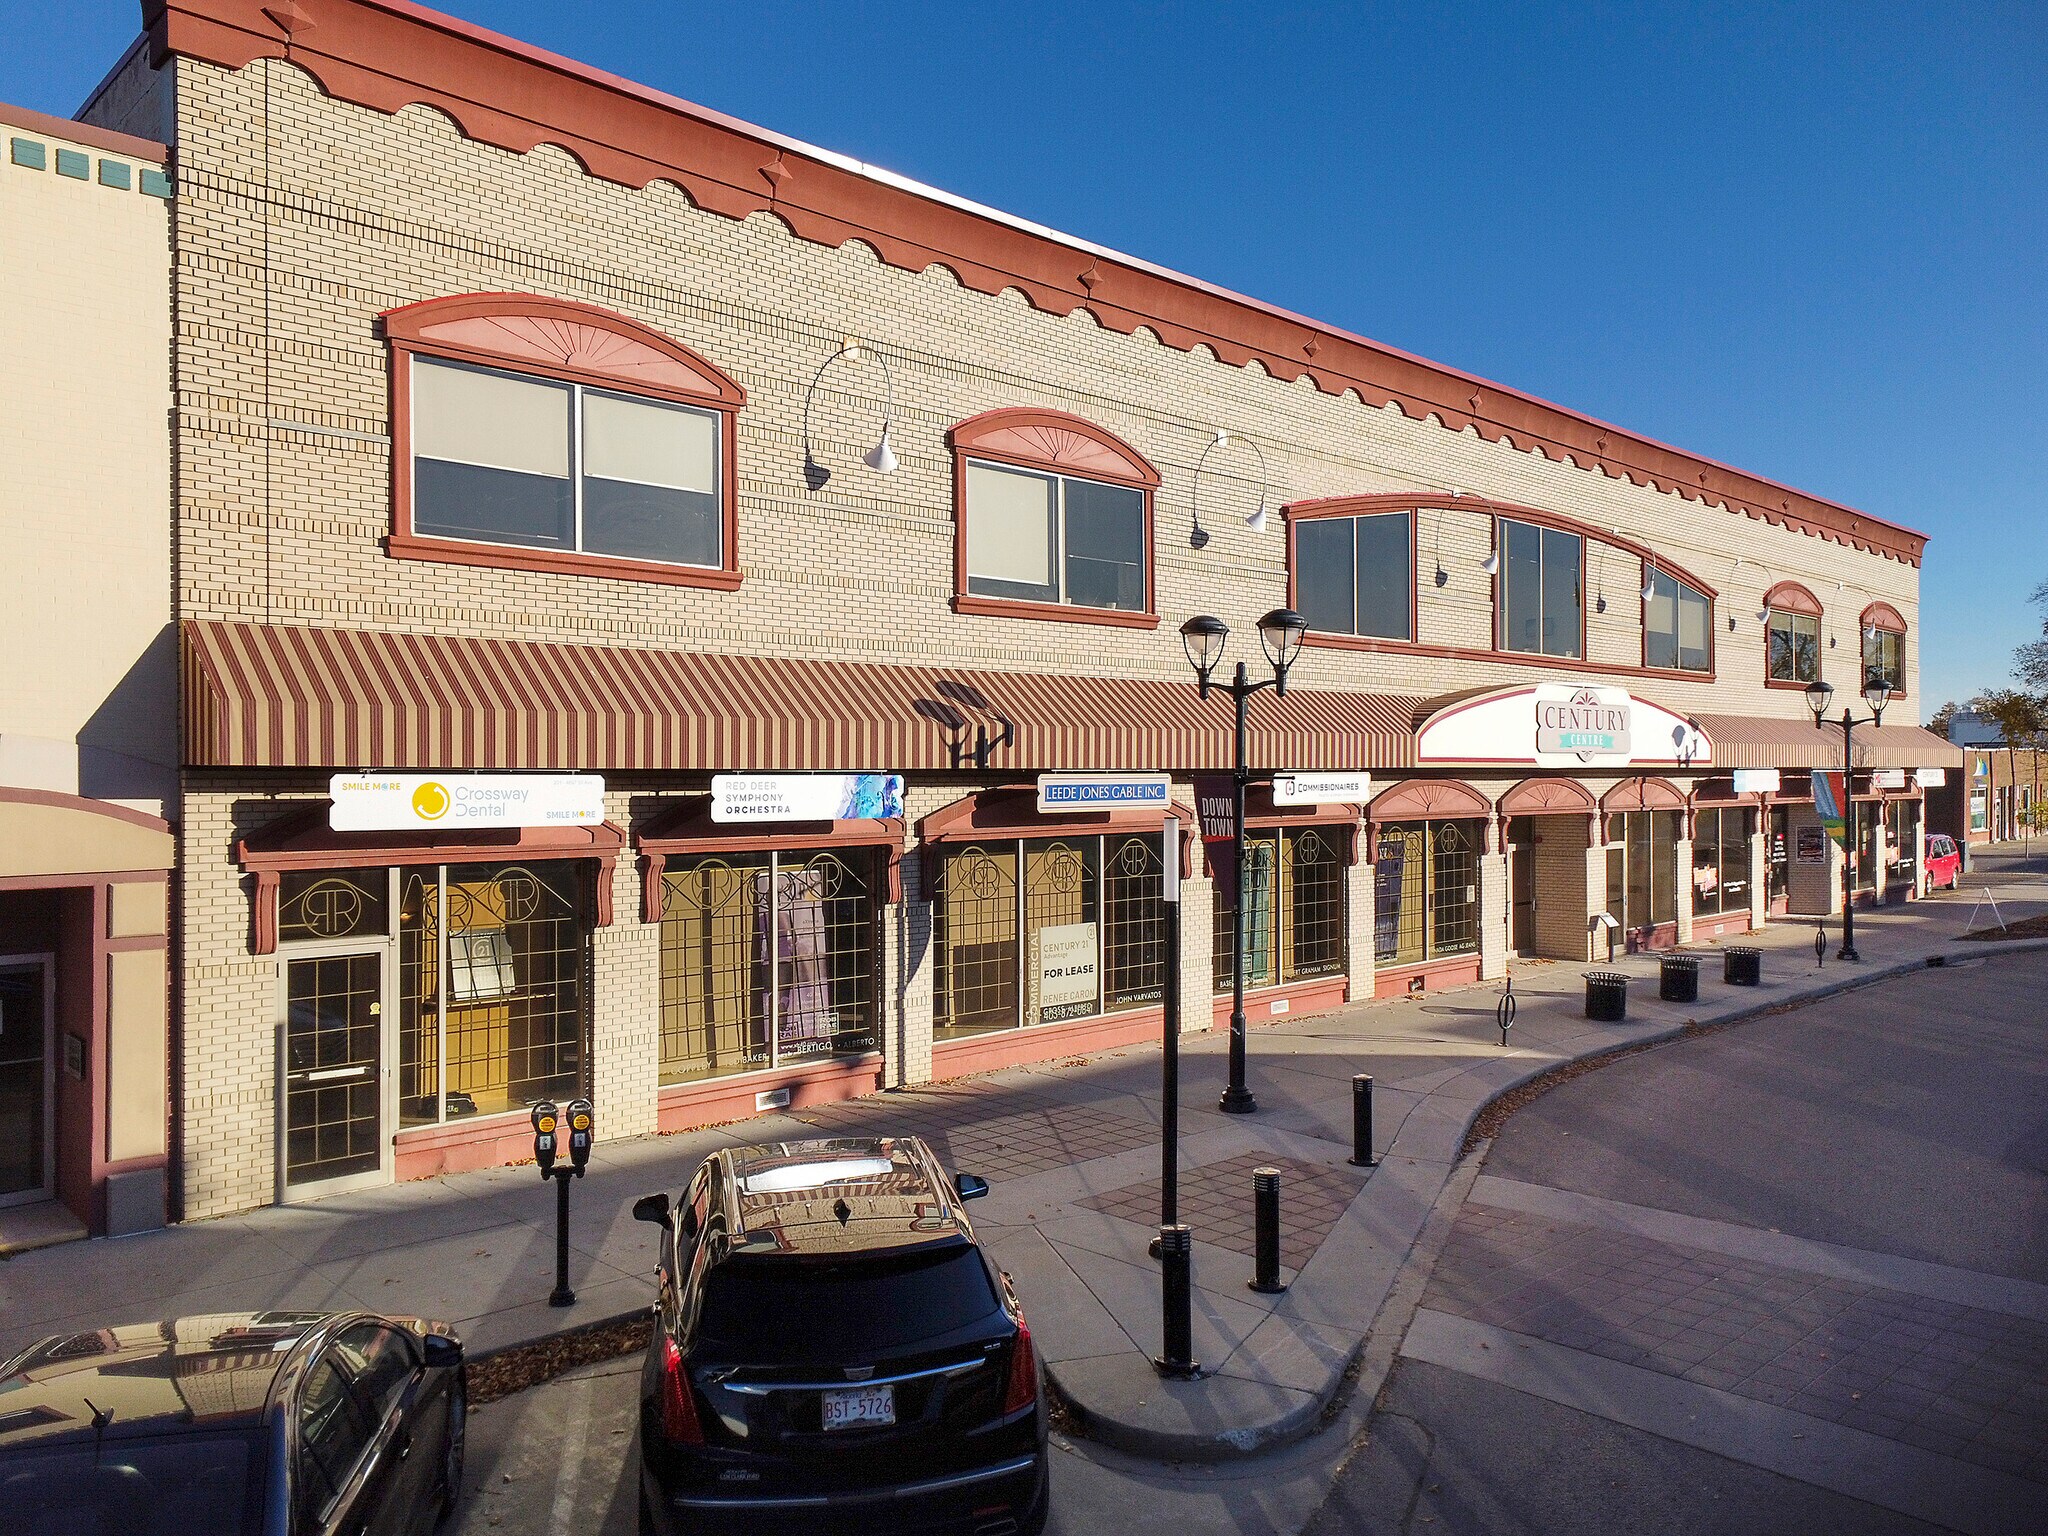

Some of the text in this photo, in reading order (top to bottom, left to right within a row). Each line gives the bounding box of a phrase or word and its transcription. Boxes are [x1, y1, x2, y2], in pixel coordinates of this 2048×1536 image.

[1545, 706, 1627, 731] CENTURY
[1570, 734, 1604, 745] CENTRE
[342, 782, 370, 791] SMILE
[725, 781, 777, 791] RED DEER
[1046, 785, 1165, 801] LEEDE JONES GABLE INC.
[455, 786, 529, 804] Crossway
[725, 793, 784, 803] SYMPHONY
[455, 802, 506, 817] Dental
[725, 805, 791, 815] ORCHESTRA
[1201, 797, 1233, 817] DOWN
[546, 811, 570, 819] SMILE
[1203, 817, 1234, 837] TOWN
[1043, 940, 1089, 953] CENTURY 21
[1030, 927, 1039, 1026] COMMERCIAL
[1044, 964, 1094, 979] FOR LEASE
[1043, 989, 1095, 1004] RENEE CARON
[1116, 991, 1161, 1004] JOHN VARVATOS
[797, 1041, 832, 1054] BERTIGO
[843, 1037, 875, 1049] ALBERTO
[743, 1053, 769, 1064] BAKER
[825, 1398, 891, 1420] BST-5726
